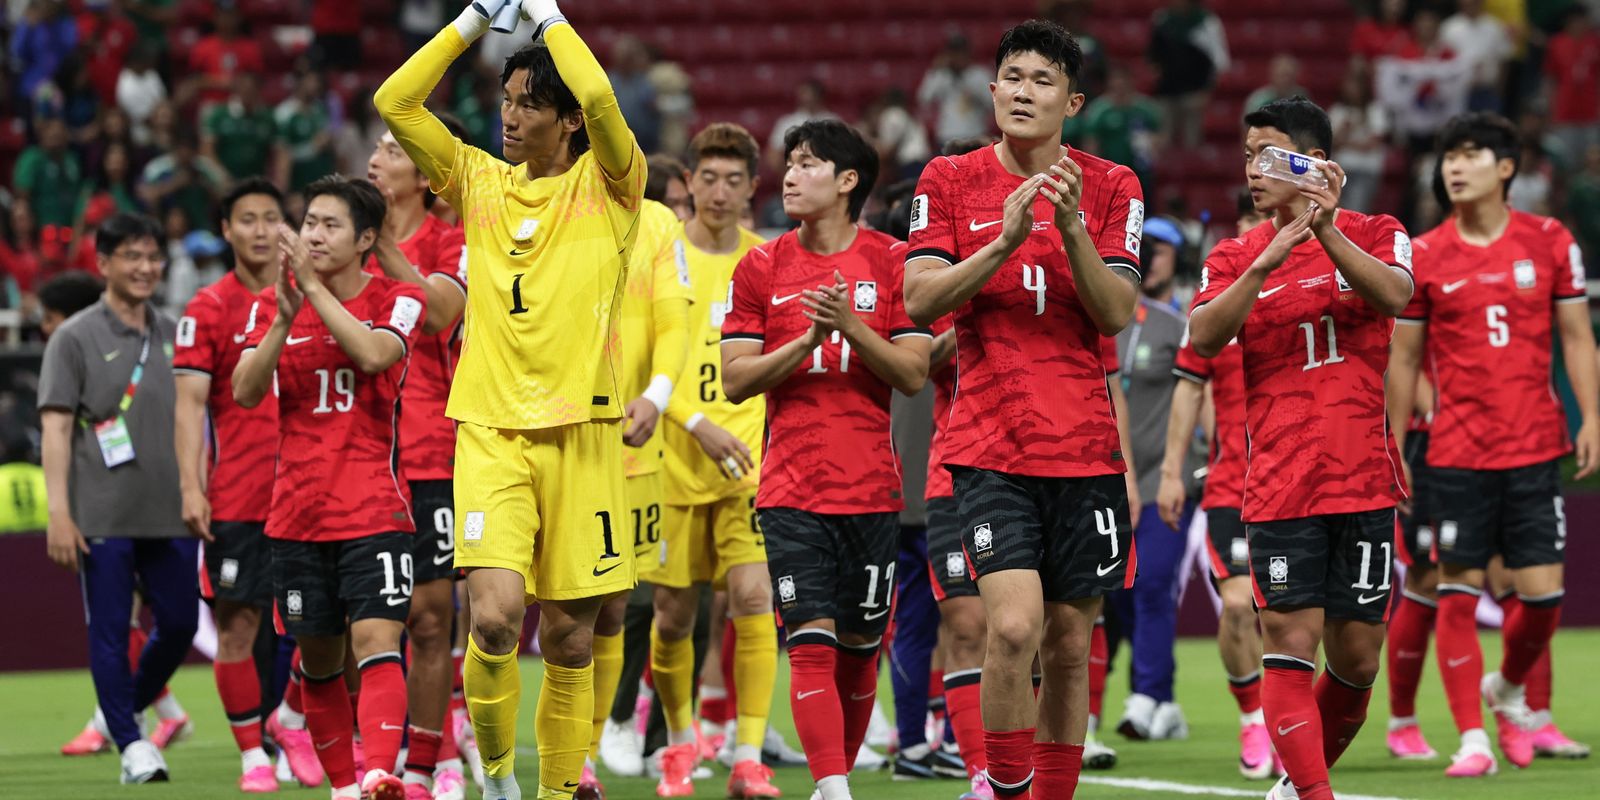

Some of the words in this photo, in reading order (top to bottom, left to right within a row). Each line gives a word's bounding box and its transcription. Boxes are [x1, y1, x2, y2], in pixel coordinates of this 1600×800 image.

[509, 273, 528, 315] 1
[1022, 263, 1046, 315] 4
[1298, 315, 1345, 371] 11
[1486, 305, 1509, 347] 5
[808, 329, 851, 374] 17
[313, 369, 355, 413] 19
[699, 364, 728, 402] 2
[434, 507, 454, 551] 9
[595, 511, 620, 559] 1
[632, 503, 661, 547] 12
[1094, 507, 1118, 559] 4
[376, 551, 414, 598] 19
[977, 551, 994, 559] KOREA
[1351, 541, 1391, 591] 11
